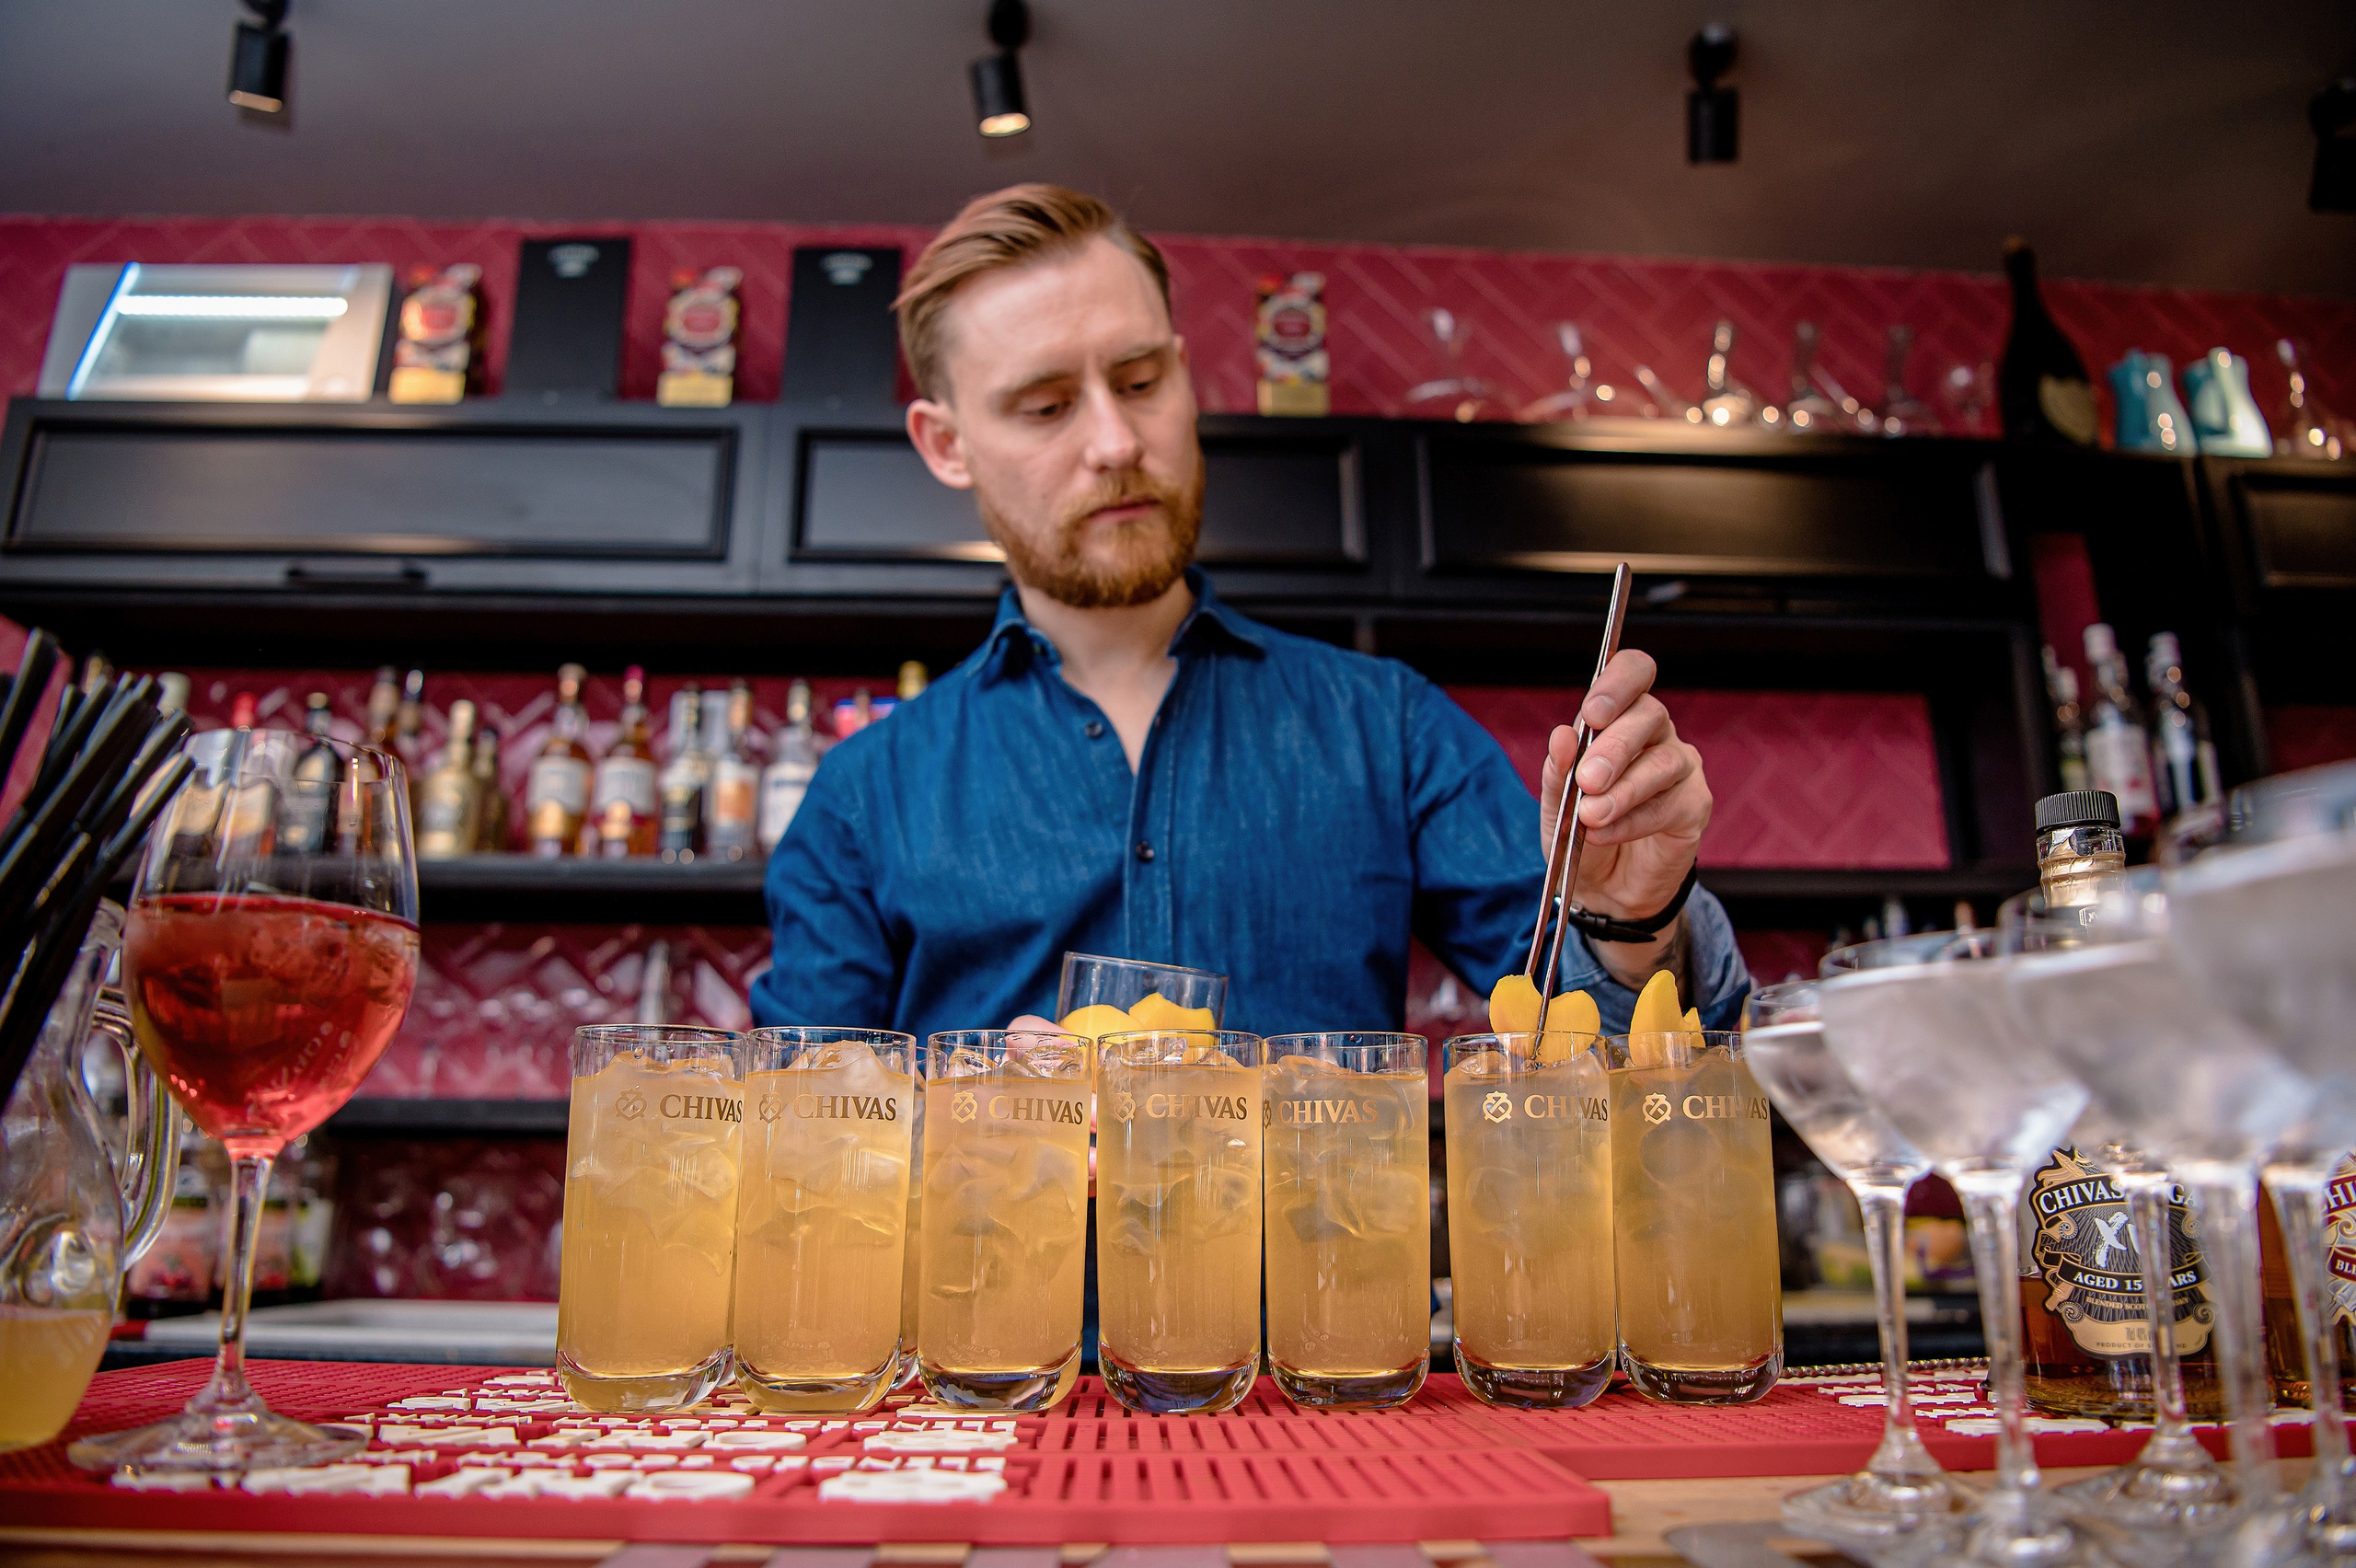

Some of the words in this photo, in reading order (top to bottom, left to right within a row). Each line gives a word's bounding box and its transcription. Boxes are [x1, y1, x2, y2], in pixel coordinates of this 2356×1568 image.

[660, 1093, 743, 1124] CHIVAS
[793, 1093, 896, 1122] CHIVAS
[987, 1099, 1083, 1125] CHIVAS
[1145, 1093, 1248, 1120] CHIVAS
[1277, 1099, 1380, 1124] CHIVAS
[1524, 1093, 1608, 1122] CHIVAS
[2038, 1179, 2126, 1214] CHIVAS
[2073, 1271, 2119, 1289] AGED
[2124, 1279, 2143, 1291] 15
[2085, 1296, 2123, 1309] BLENDED
